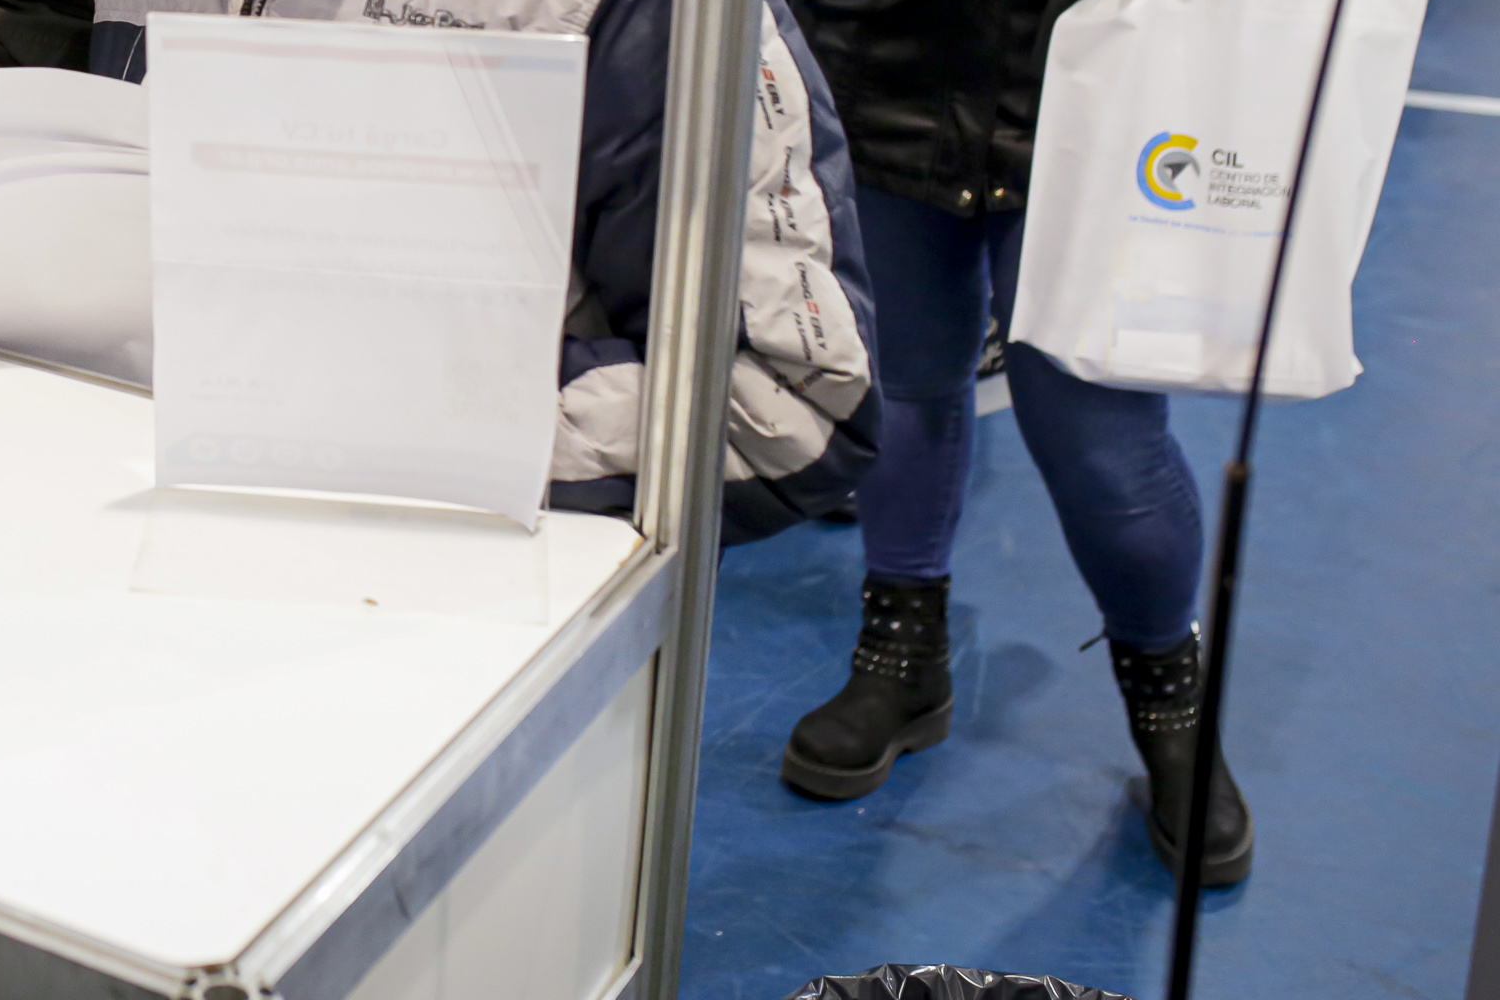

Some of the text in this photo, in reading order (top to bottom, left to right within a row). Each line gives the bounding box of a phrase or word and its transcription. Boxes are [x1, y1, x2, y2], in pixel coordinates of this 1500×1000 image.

[1211, 148, 1244, 168] CIL
[1209, 169, 1280, 183] CENTRO DE
[1207, 194, 1263, 210] LABORAL
